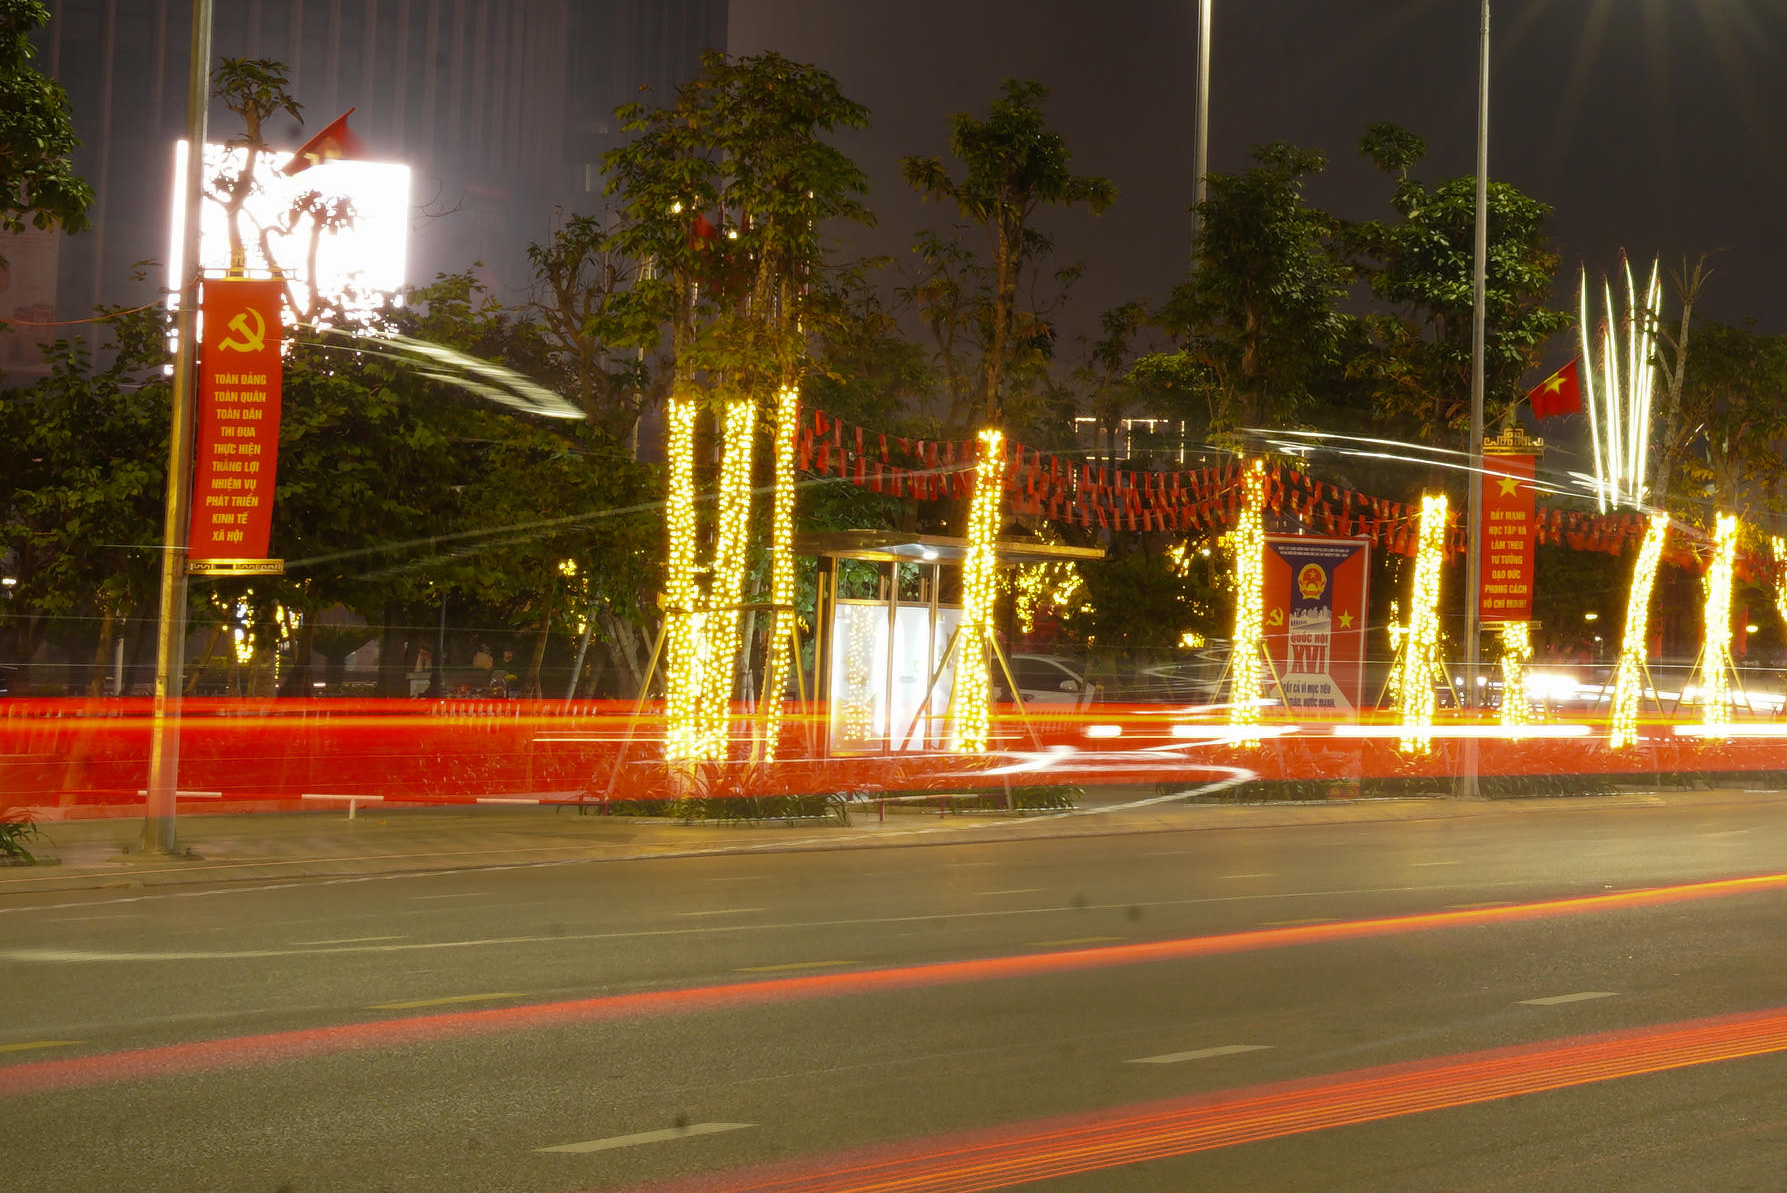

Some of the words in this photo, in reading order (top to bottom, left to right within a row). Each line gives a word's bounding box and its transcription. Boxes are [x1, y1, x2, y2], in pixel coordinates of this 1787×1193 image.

[214, 372, 239, 385] TOÀN
[240, 372, 267, 385] ĐẢNG
[214, 390, 239, 402] TOÀN
[240, 390, 267, 403] QUÂN
[216, 407, 240, 419] TOÀN
[242, 407, 263, 420] DÂN
[221, 426, 235, 437] THI
[236, 427, 256, 437] ĐUA
[213, 443, 237, 456] THỰC
[238, 442, 261, 457] HIỆN
[212, 459, 242, 473] THẮNG
[244, 461, 260, 474] LỢI
[211, 476, 242, 491] NHIỆM
[244, 478, 257, 492] VỤ
[206, 493, 230, 506] PHÁT
[231, 493, 259, 507] TRIỂN
[212, 513, 235, 524] KINH
[237, 510, 249, 524] TẾ
[212, 529, 225, 541] XÃ
[226, 529, 244, 544] HỘI
[1507, 540, 1524, 550] THEO
[1484, 584, 1508, 594] PHONG
[1508, 583, 1528, 594] CÁCH
[1290, 630, 1312, 644] QUỐC
[1288, 644, 1329, 675] XVI
